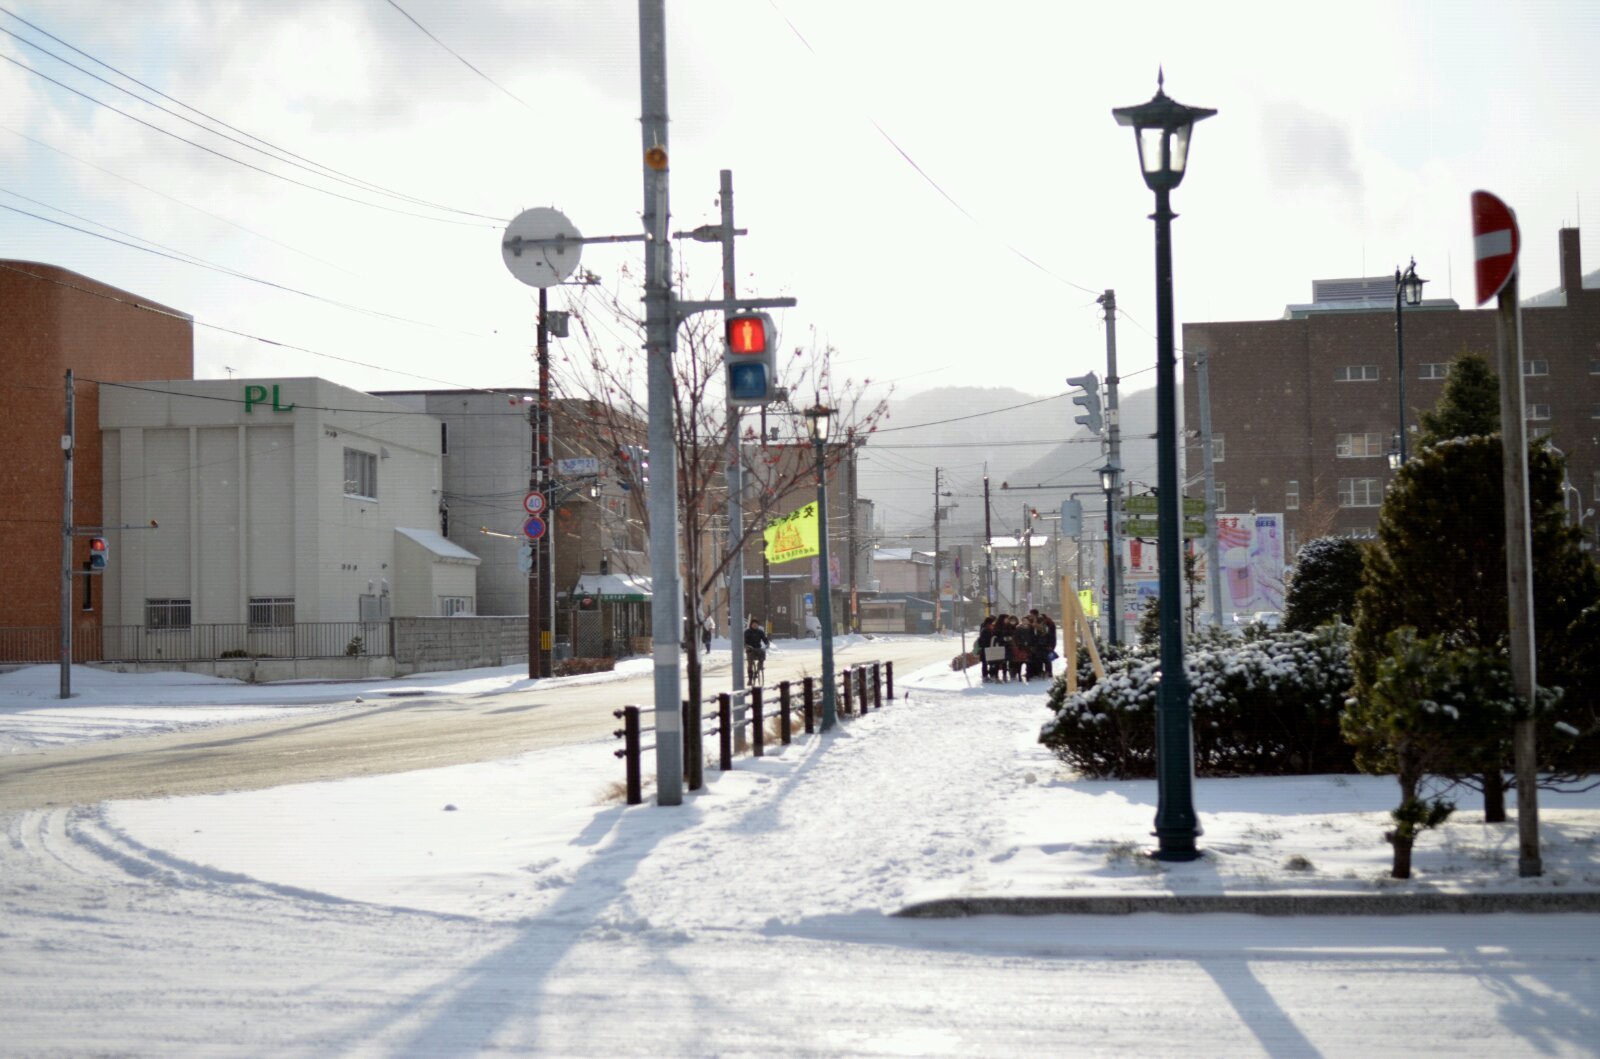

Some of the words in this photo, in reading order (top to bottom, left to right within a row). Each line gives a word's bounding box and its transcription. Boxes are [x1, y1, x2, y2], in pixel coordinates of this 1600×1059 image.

[245, 384, 295, 413] PL
[528, 498, 540, 508] 40
[1216, 517, 1240, 528] ます
[1255, 520, 1276, 528] BEER
